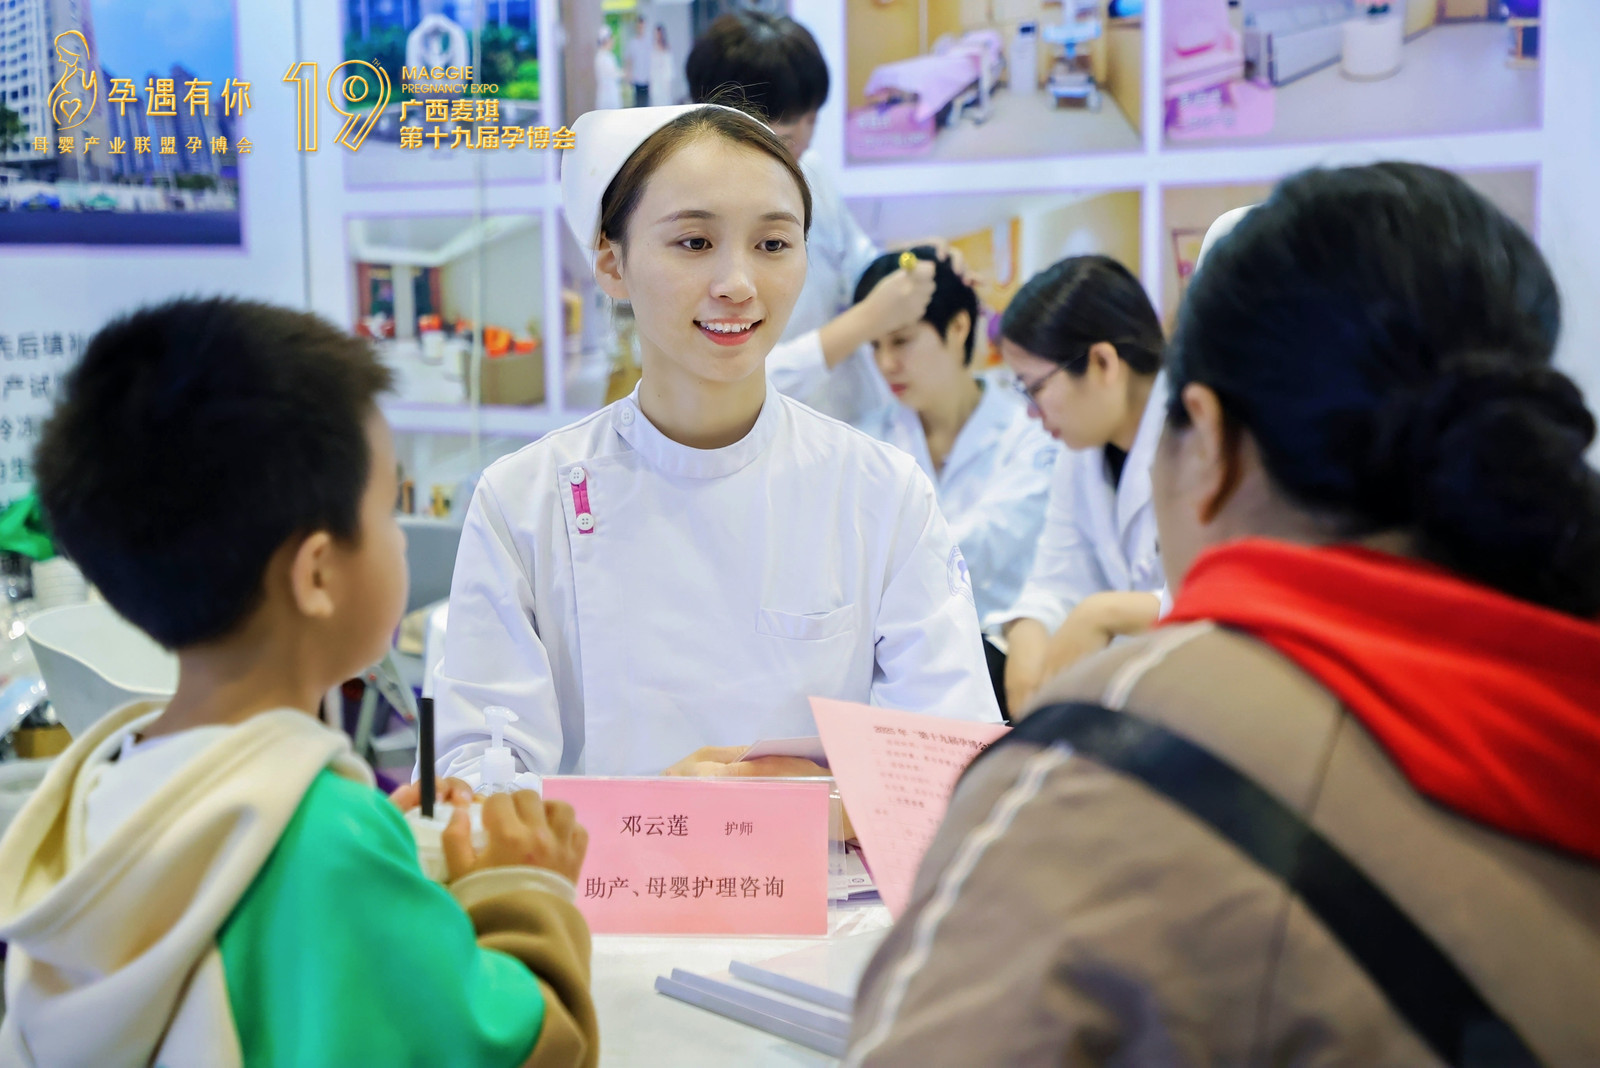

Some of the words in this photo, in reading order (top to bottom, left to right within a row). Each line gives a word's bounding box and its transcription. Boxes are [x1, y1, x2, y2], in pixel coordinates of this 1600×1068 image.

[620, 814, 689, 837] 邓云莲
[724, 821, 753, 836] 护师
[584, 876, 785, 899] 助产、母婴护理咨询
